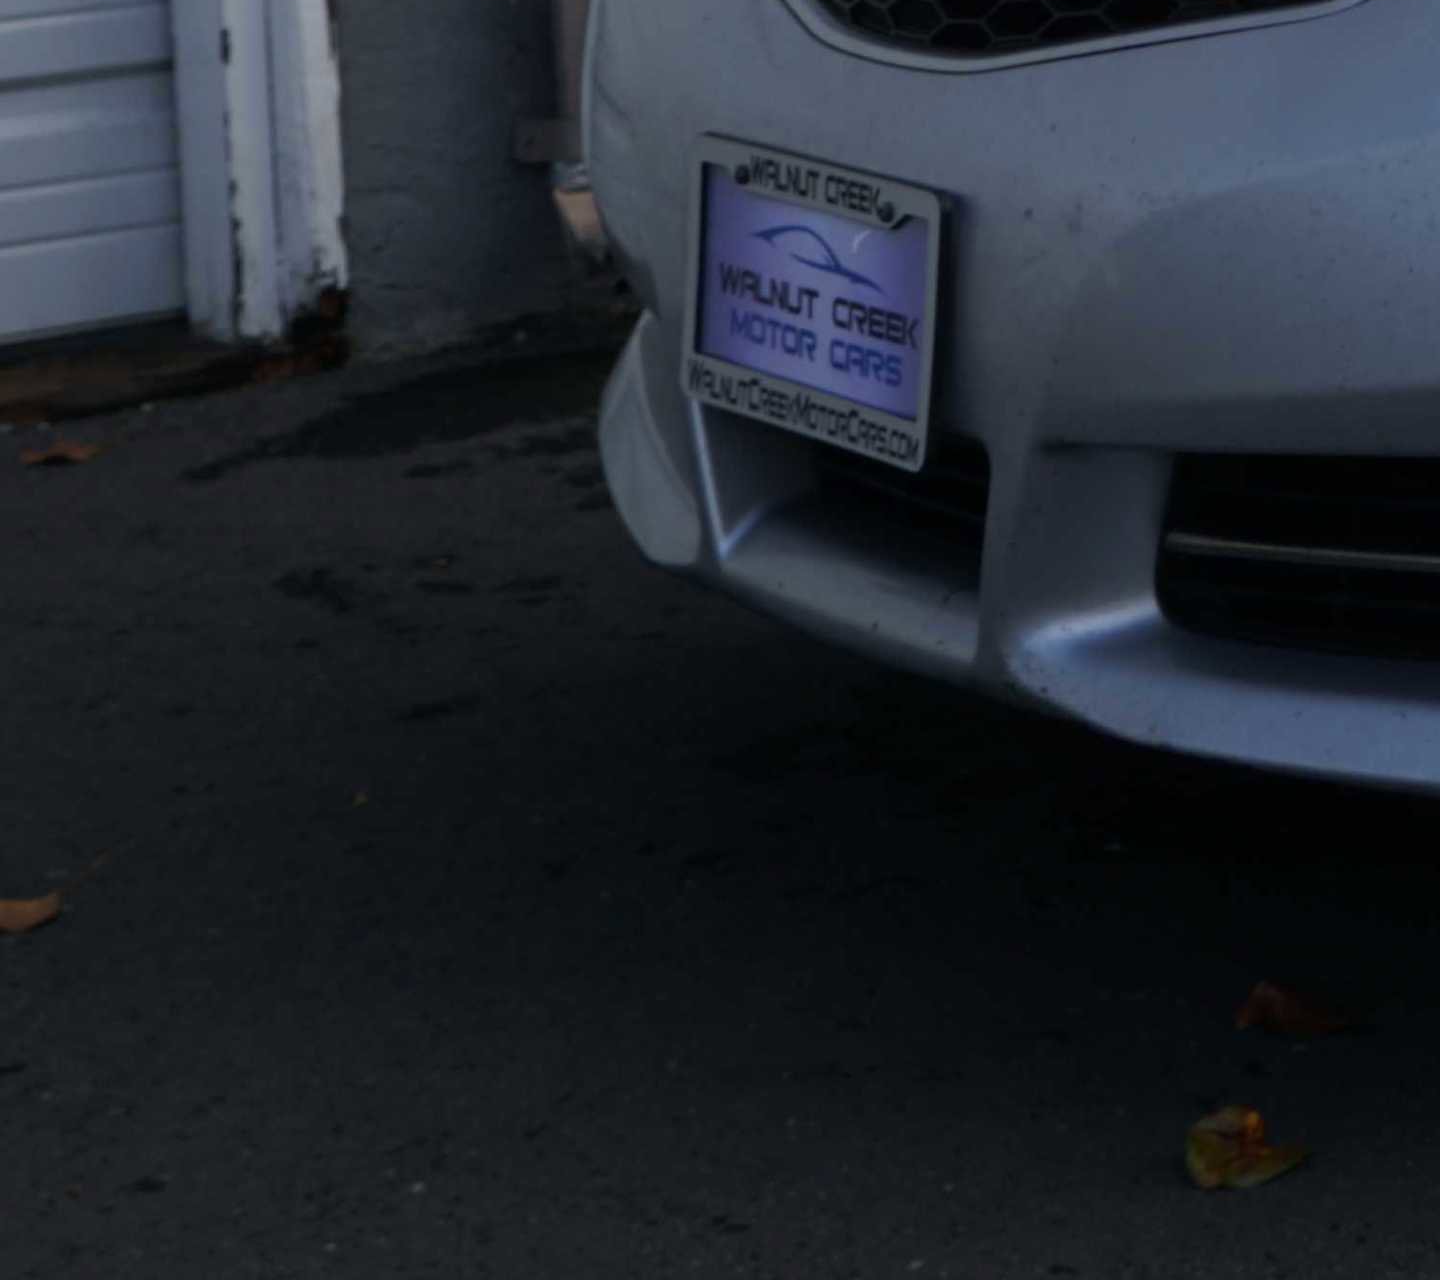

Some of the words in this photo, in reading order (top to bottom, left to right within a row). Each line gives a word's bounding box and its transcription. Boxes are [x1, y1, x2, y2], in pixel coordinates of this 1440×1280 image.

[750, 156, 820, 201] WALNUT
[824, 175, 882, 216] CREEK
[719, 263, 820, 320] WALNUT
[831, 297, 919, 351] CREEK
[730, 307, 818, 362] MOTOR
[829, 339, 902, 388] CARS
